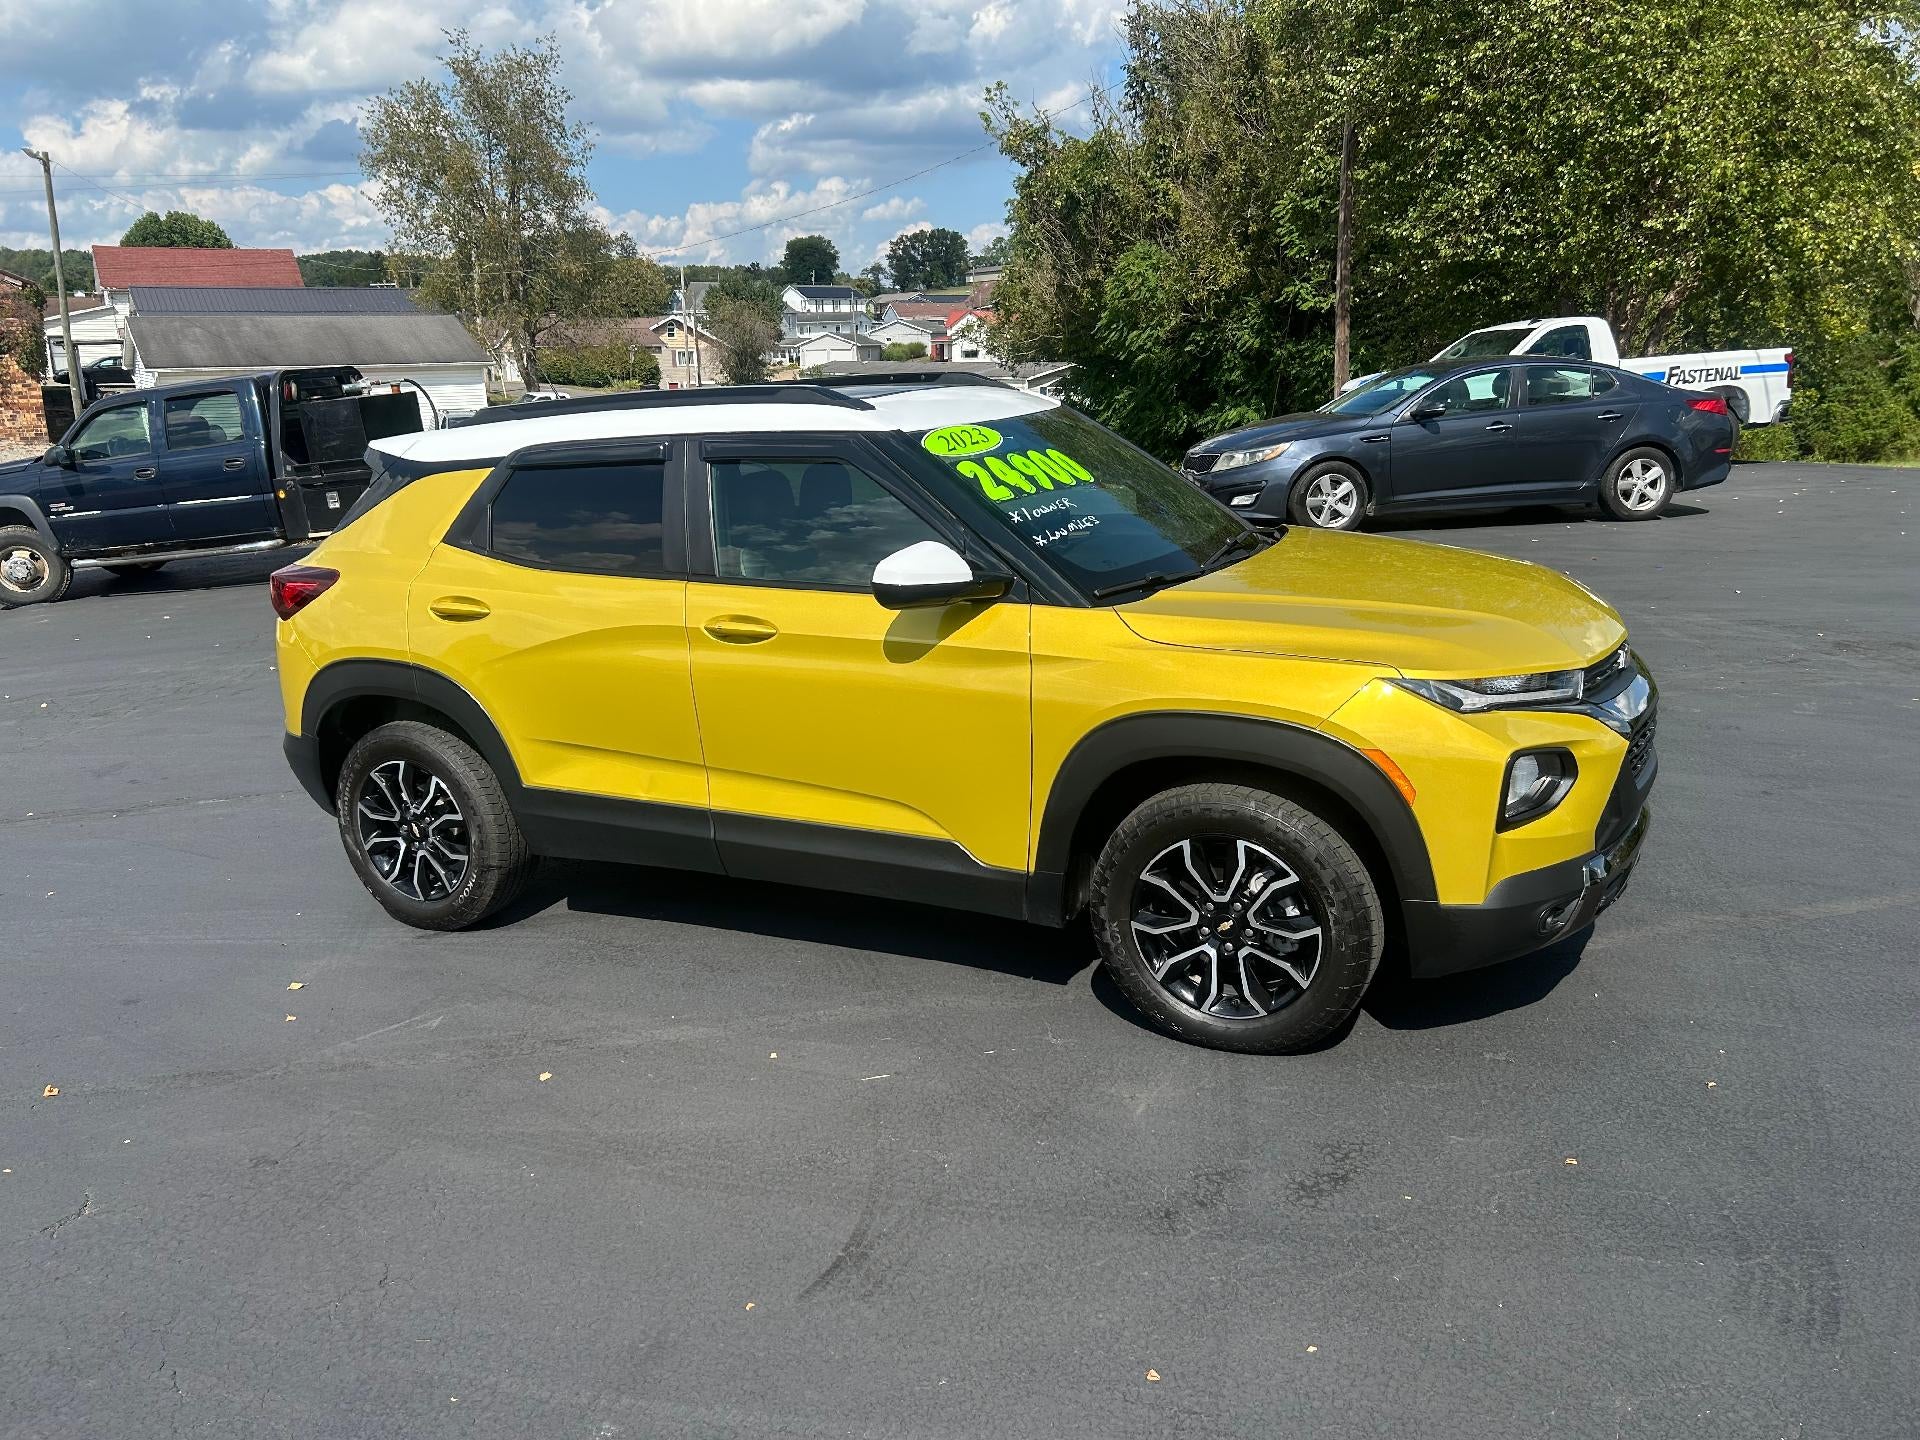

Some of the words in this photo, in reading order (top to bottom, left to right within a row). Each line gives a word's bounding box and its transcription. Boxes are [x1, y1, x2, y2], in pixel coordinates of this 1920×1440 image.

[1666, 366, 1741, 384] FASTENAL
[937, 428, 990, 451] 2023
[957, 449, 1094, 500] 24900
